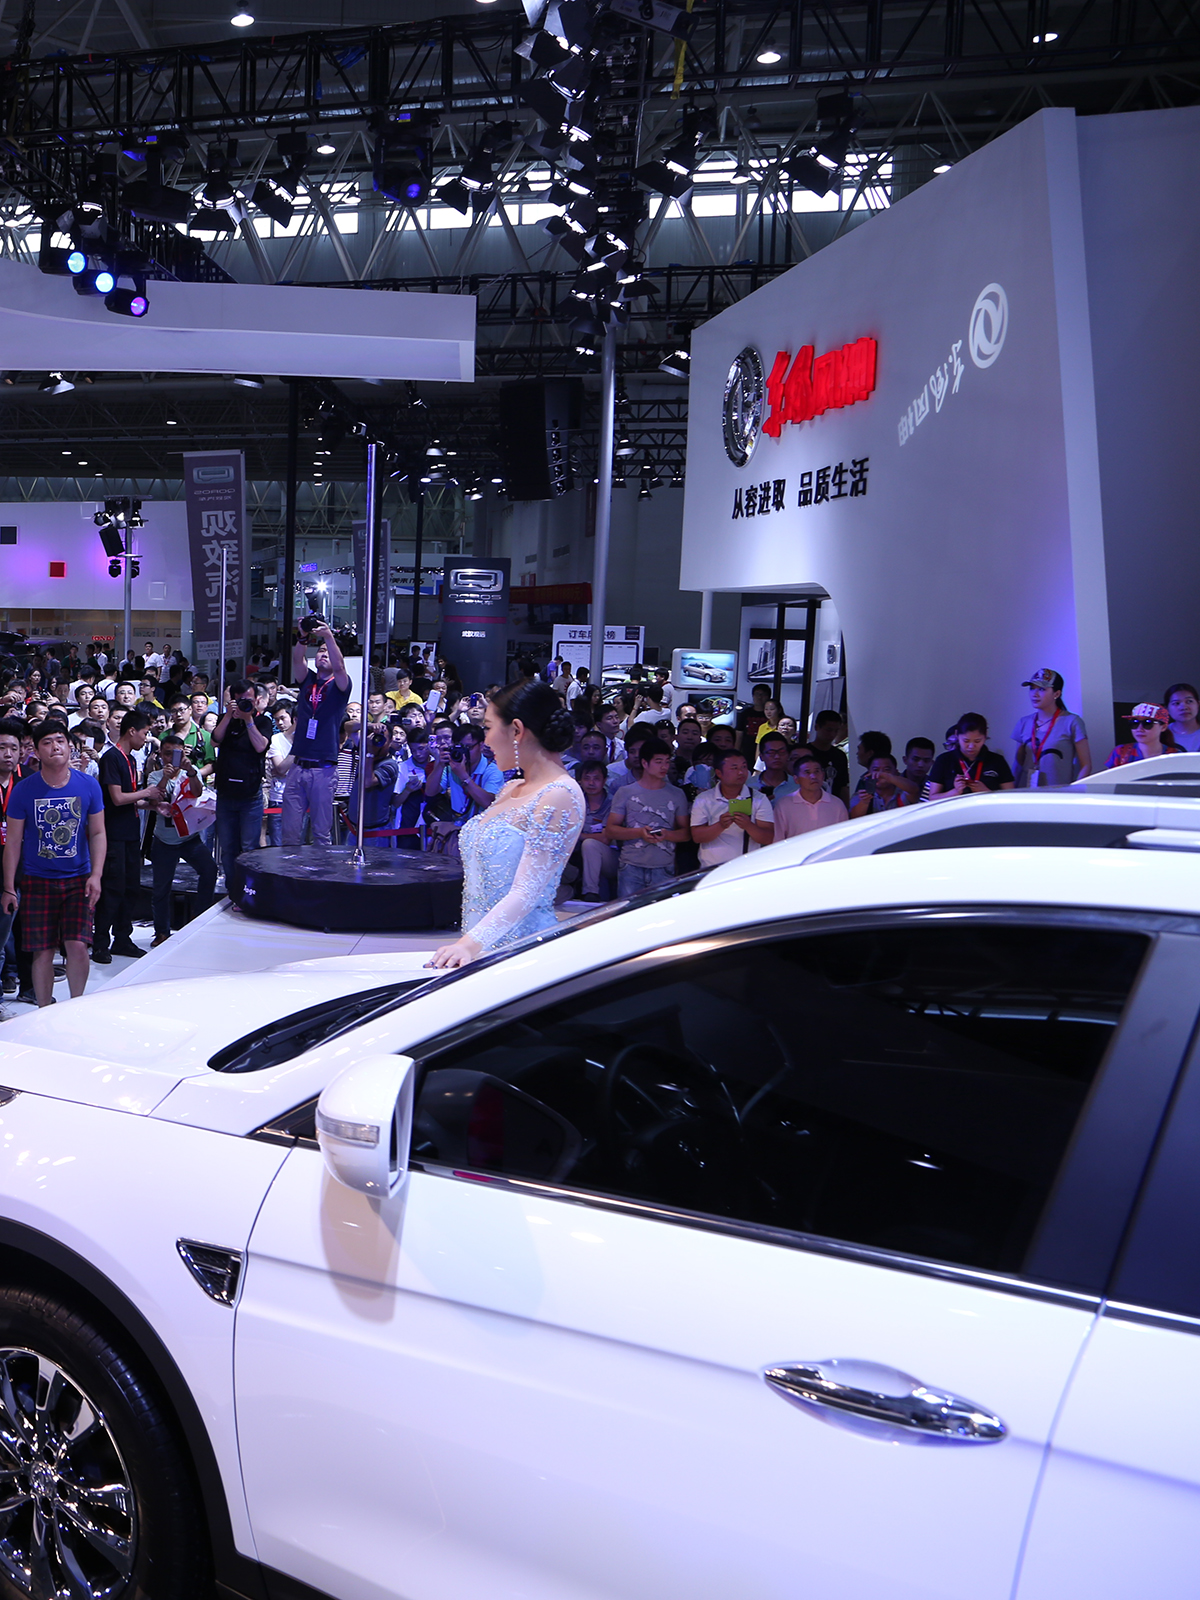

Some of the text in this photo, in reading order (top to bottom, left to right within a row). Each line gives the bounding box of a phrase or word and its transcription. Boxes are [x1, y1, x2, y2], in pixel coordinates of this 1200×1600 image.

[731, 457, 870, 520] 从容进取 品质生活
[568, 629, 617, 640] 订车榜
